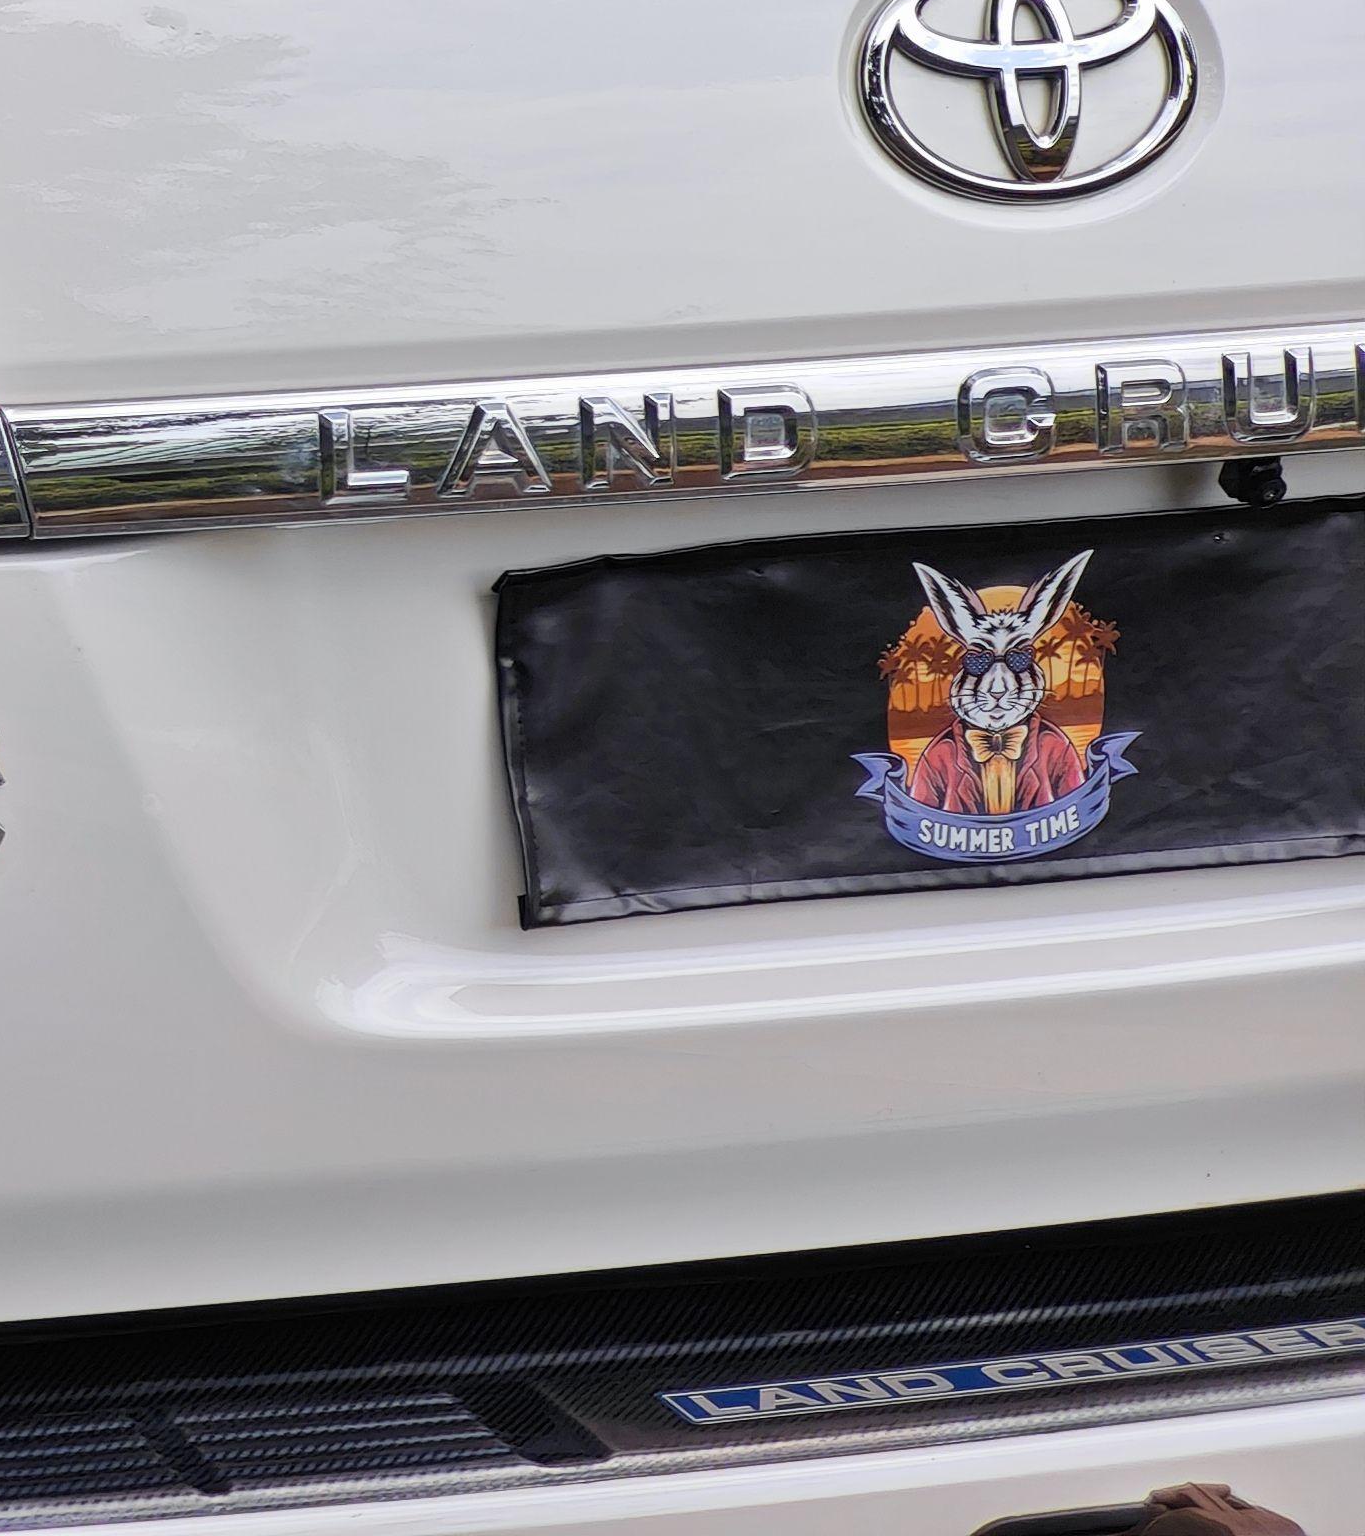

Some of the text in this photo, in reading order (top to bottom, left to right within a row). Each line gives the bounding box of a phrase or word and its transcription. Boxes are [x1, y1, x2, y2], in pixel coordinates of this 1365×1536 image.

[318, 380, 819, 505] LAND
[917, 804, 1080, 853] SUMMER TIME
[688, 1322, 1365, 1416] LAND CRUISER
